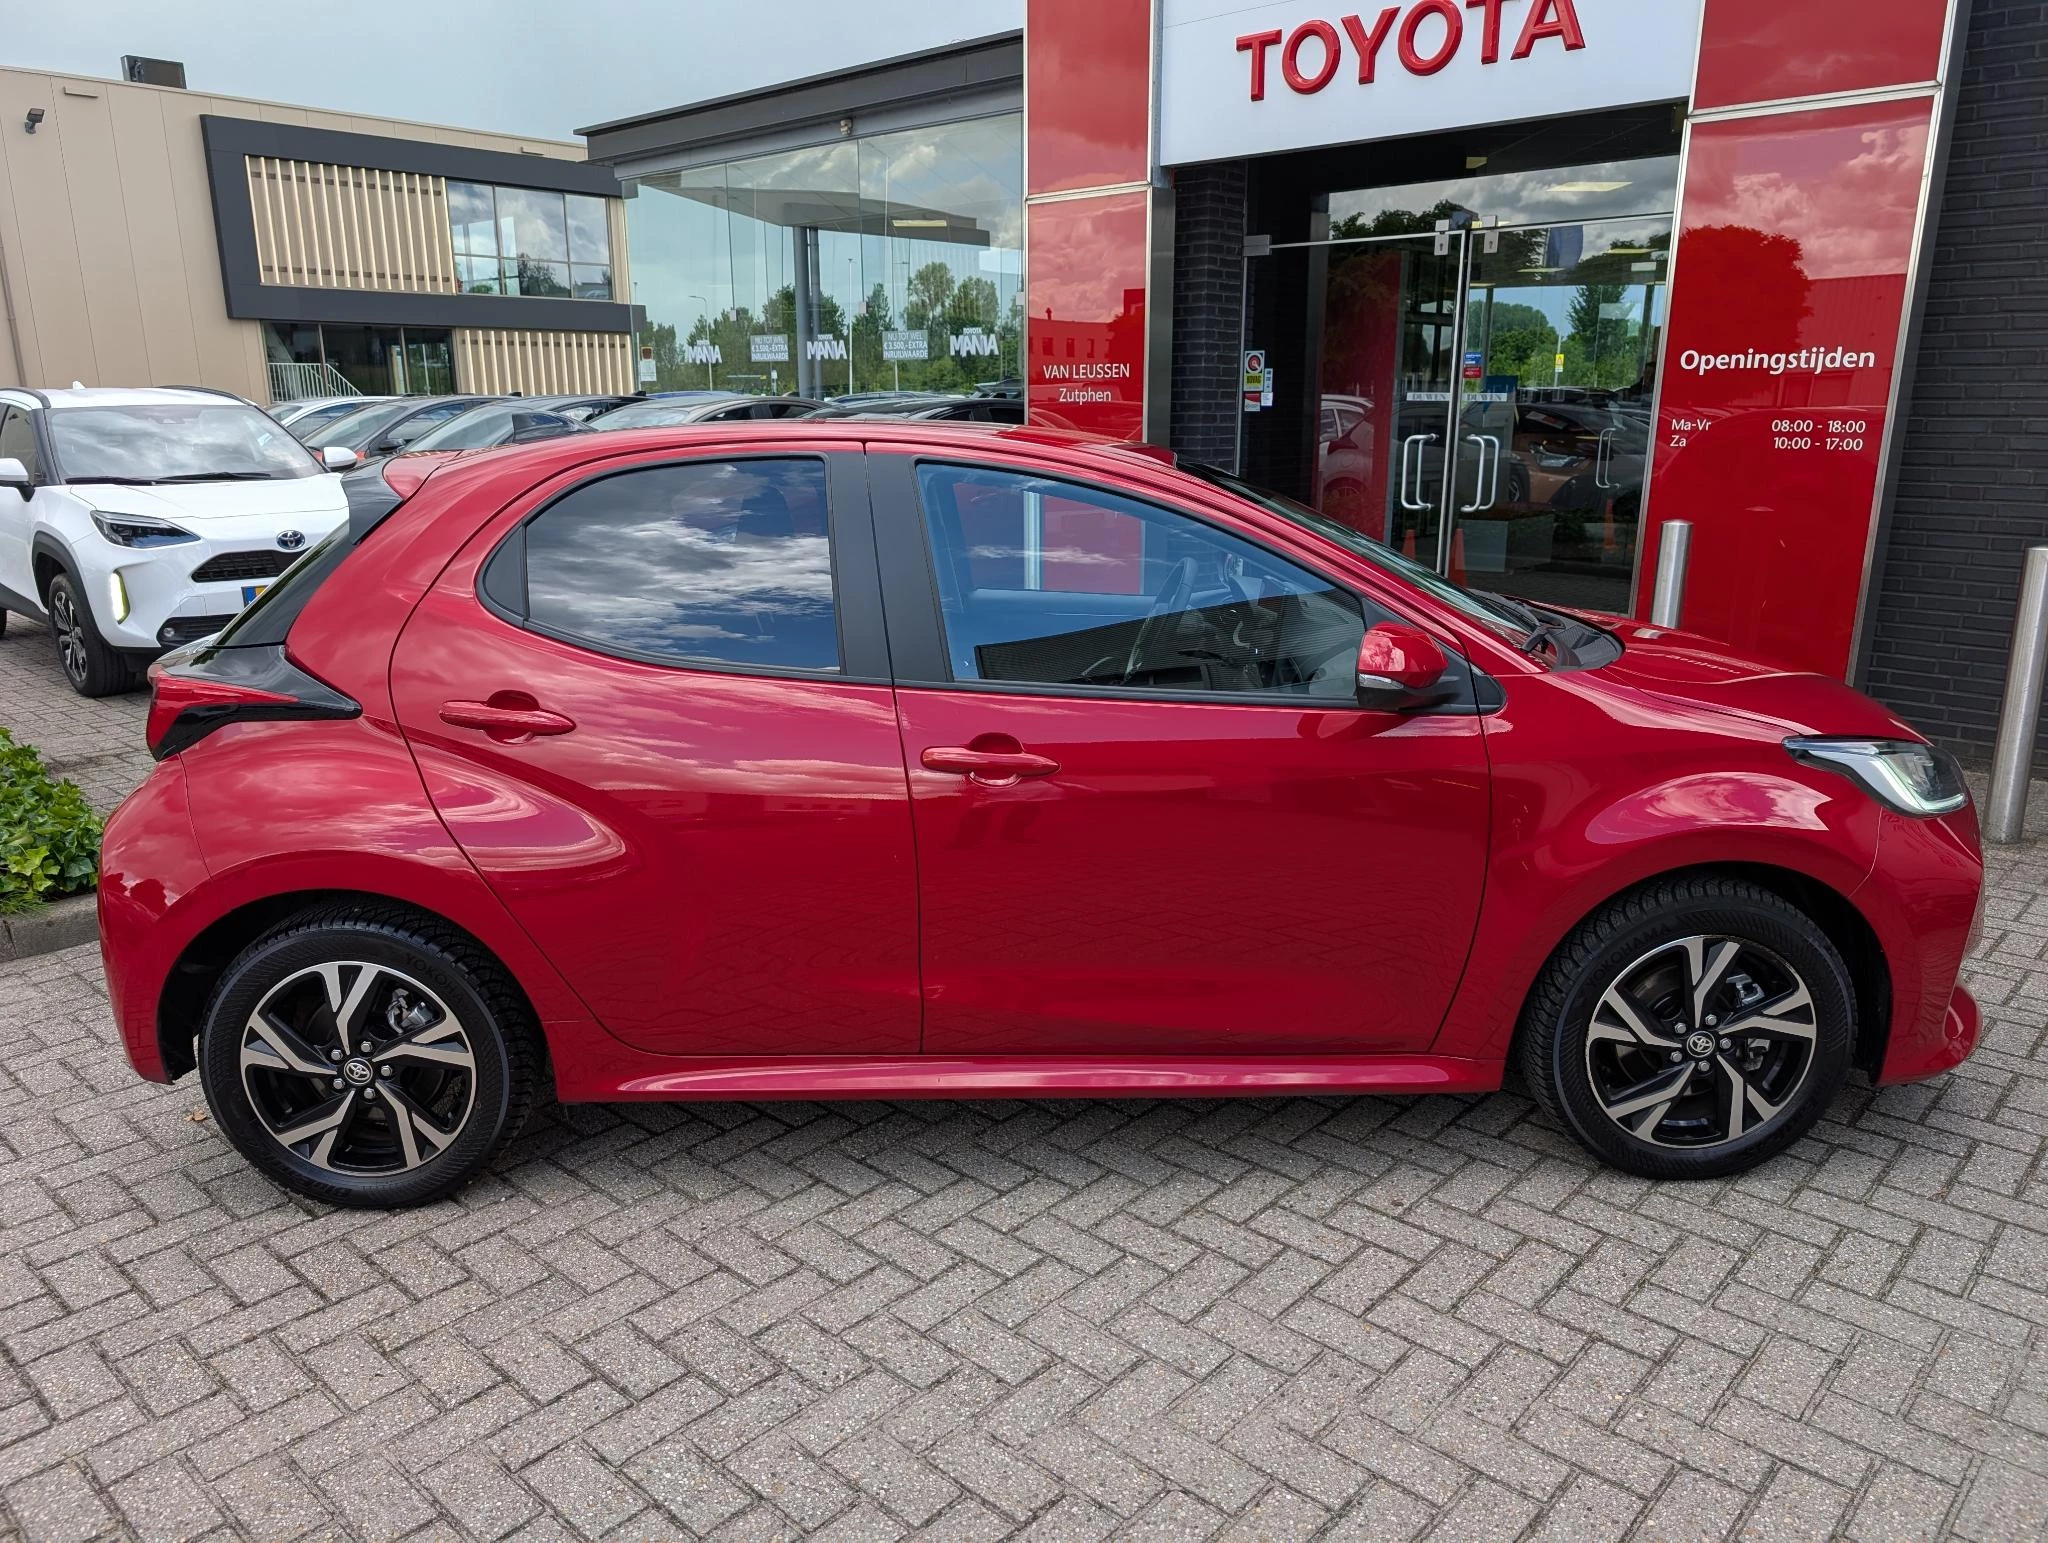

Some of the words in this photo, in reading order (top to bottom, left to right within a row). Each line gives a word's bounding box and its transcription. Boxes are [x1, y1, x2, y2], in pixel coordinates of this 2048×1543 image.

[1236, 0, 1586, 102] TOYOTA
[688, 344, 722, 364] MANIA
[807, 340, 848, 360] MANIA
[949, 333, 999, 357] MANIA
[1680, 346, 1875, 375] Openingstijden
[1043, 364, 1069, 379] VAN
[1072, 363, 1130, 378] LEUSSEN
[1059, 387, 1112, 405] Zutphen
[1671, 418, 1712, 432] Ma-Vr
[1771, 419, 1813, 433] 08:00
[1827, 420, 1866, 433] 18:00
[1670, 434, 1687, 447] Za
[1773, 436, 1811, 450] 10:00
[1824, 437, 1863, 451] 17:00
